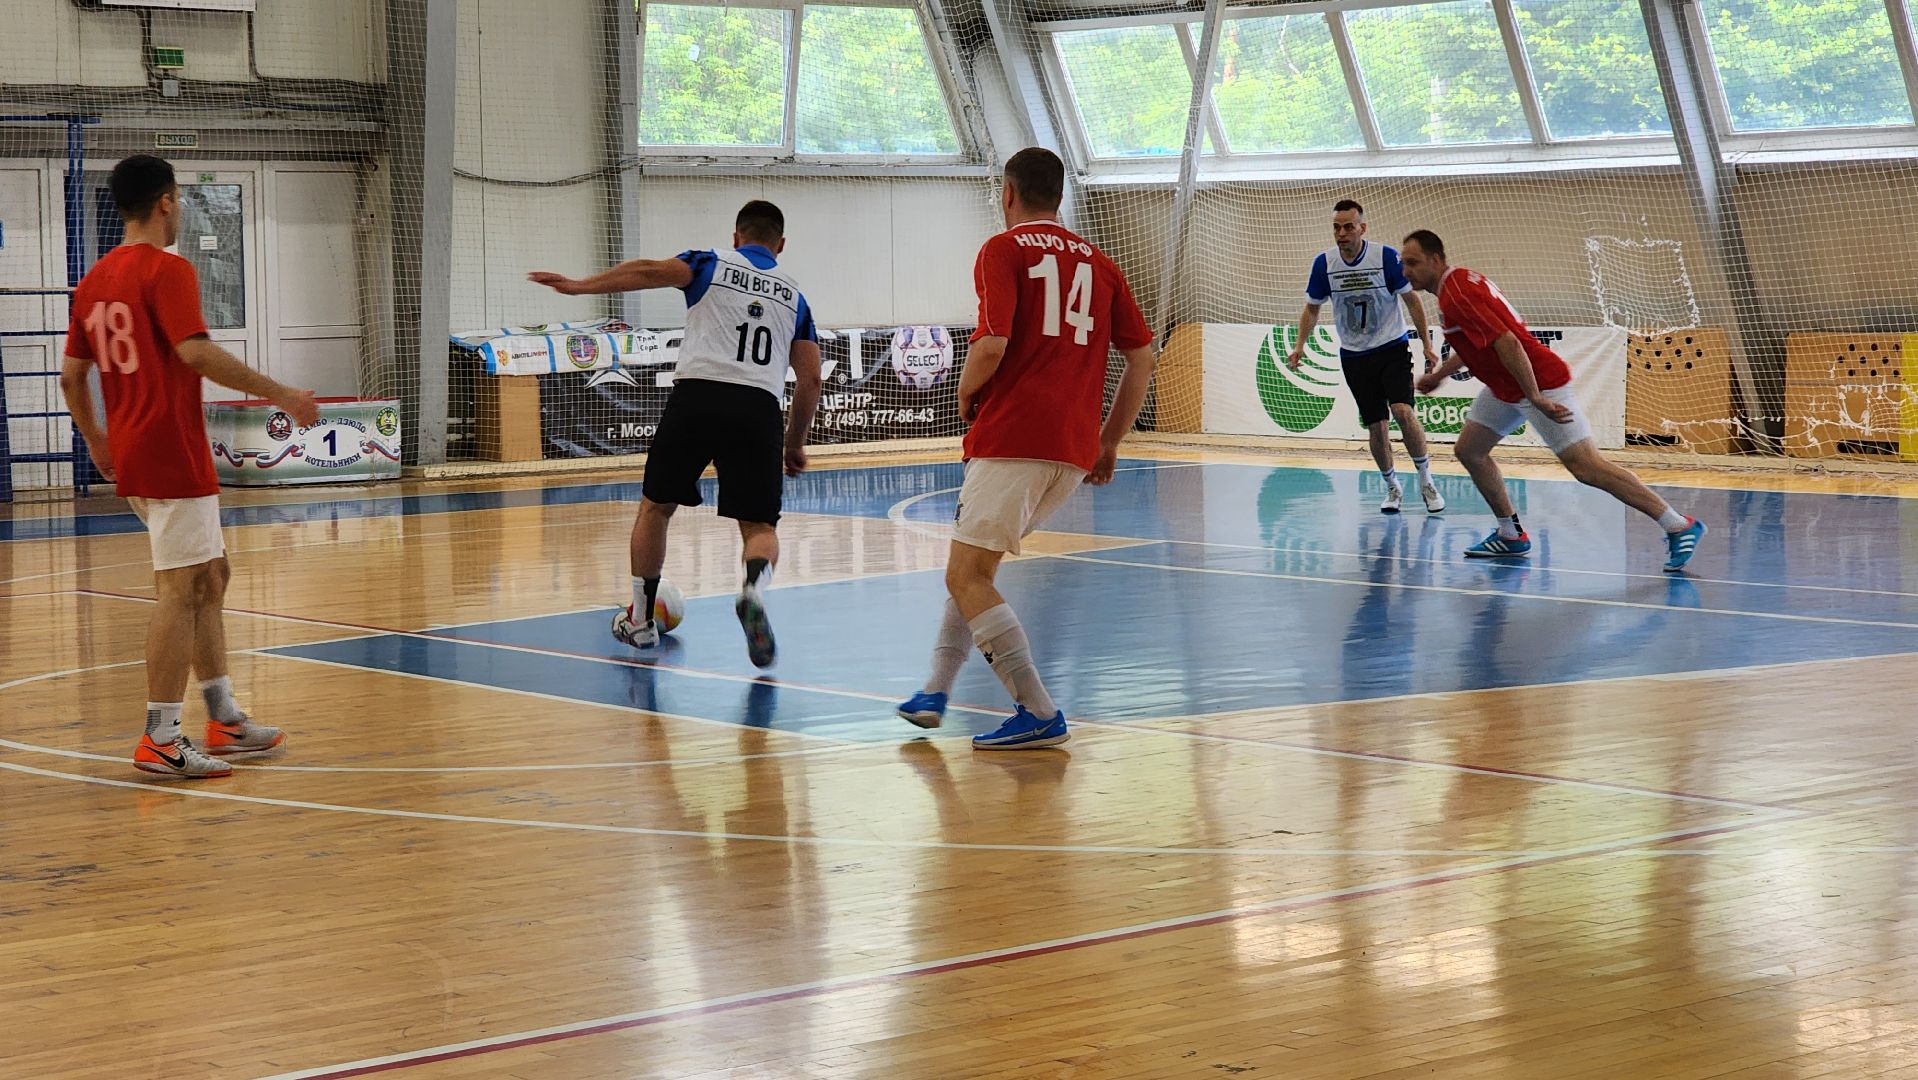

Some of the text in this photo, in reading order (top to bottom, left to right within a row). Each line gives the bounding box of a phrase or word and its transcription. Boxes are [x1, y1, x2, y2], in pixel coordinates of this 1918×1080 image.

[159, 135, 195, 145] ВЫХОД
[1014, 233, 1093, 257] НЦУО РФ
[723, 267, 793, 301] ГВЦ ВС РФ
[1027, 254, 1094, 346] 14
[1354, 301, 1367, 329] 7
[84, 301, 140, 375] 18
[735, 322, 772, 366] 10
[906, 353, 940, 367] SELECT
[822, 392, 877, 412] ЦЕНТР:
[298, 418, 328, 436] САМБО
[337, 417, 366, 434] ДЗЮДО
[607, 422, 659, 439] г. Моск
[824, 413, 833, 428] 8
[836, 411, 868, 430] (495)
[872, 408, 935, 425] 777-66-43
[322, 430, 337, 457] 1
[304, 452, 362, 468] КОТЕЛЬНИКИ
